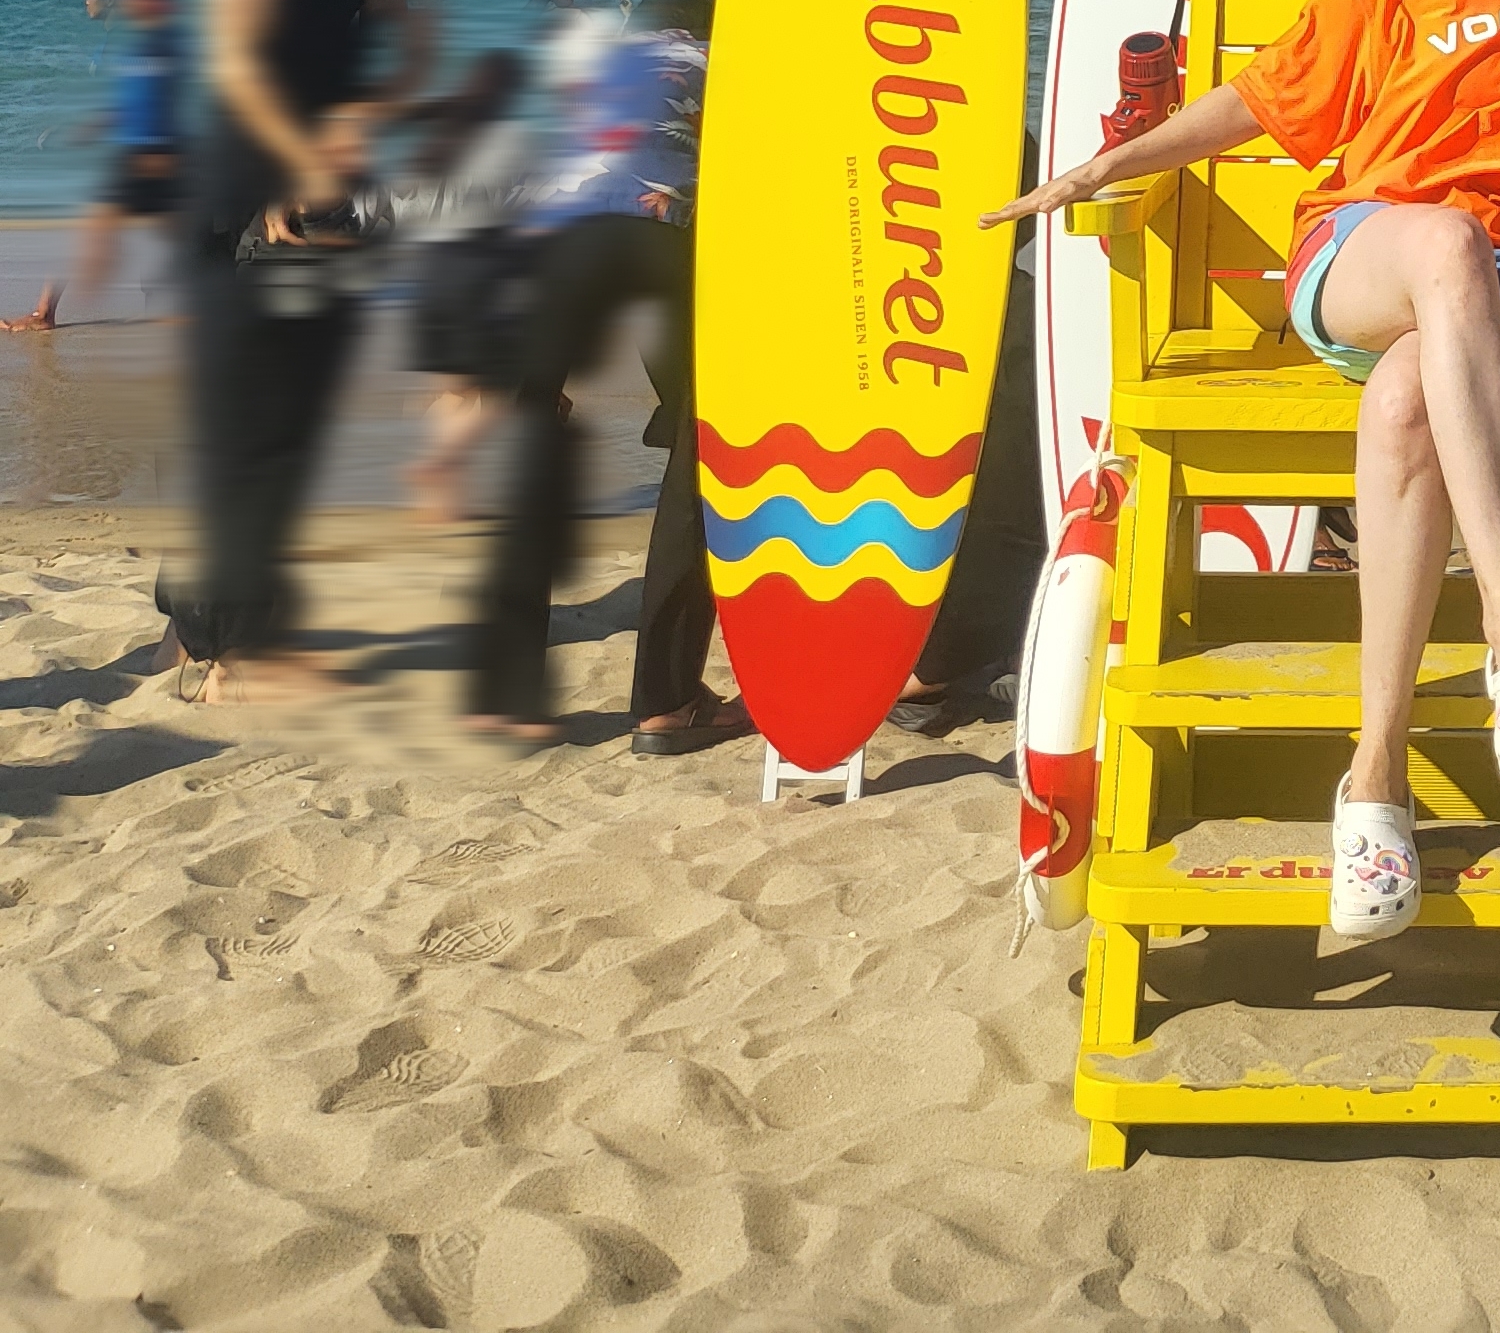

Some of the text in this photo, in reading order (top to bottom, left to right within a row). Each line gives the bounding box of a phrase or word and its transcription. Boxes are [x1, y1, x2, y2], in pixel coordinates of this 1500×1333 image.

[846, 155, 870, 391] DEN ORIGINALE SIDEN 1958
